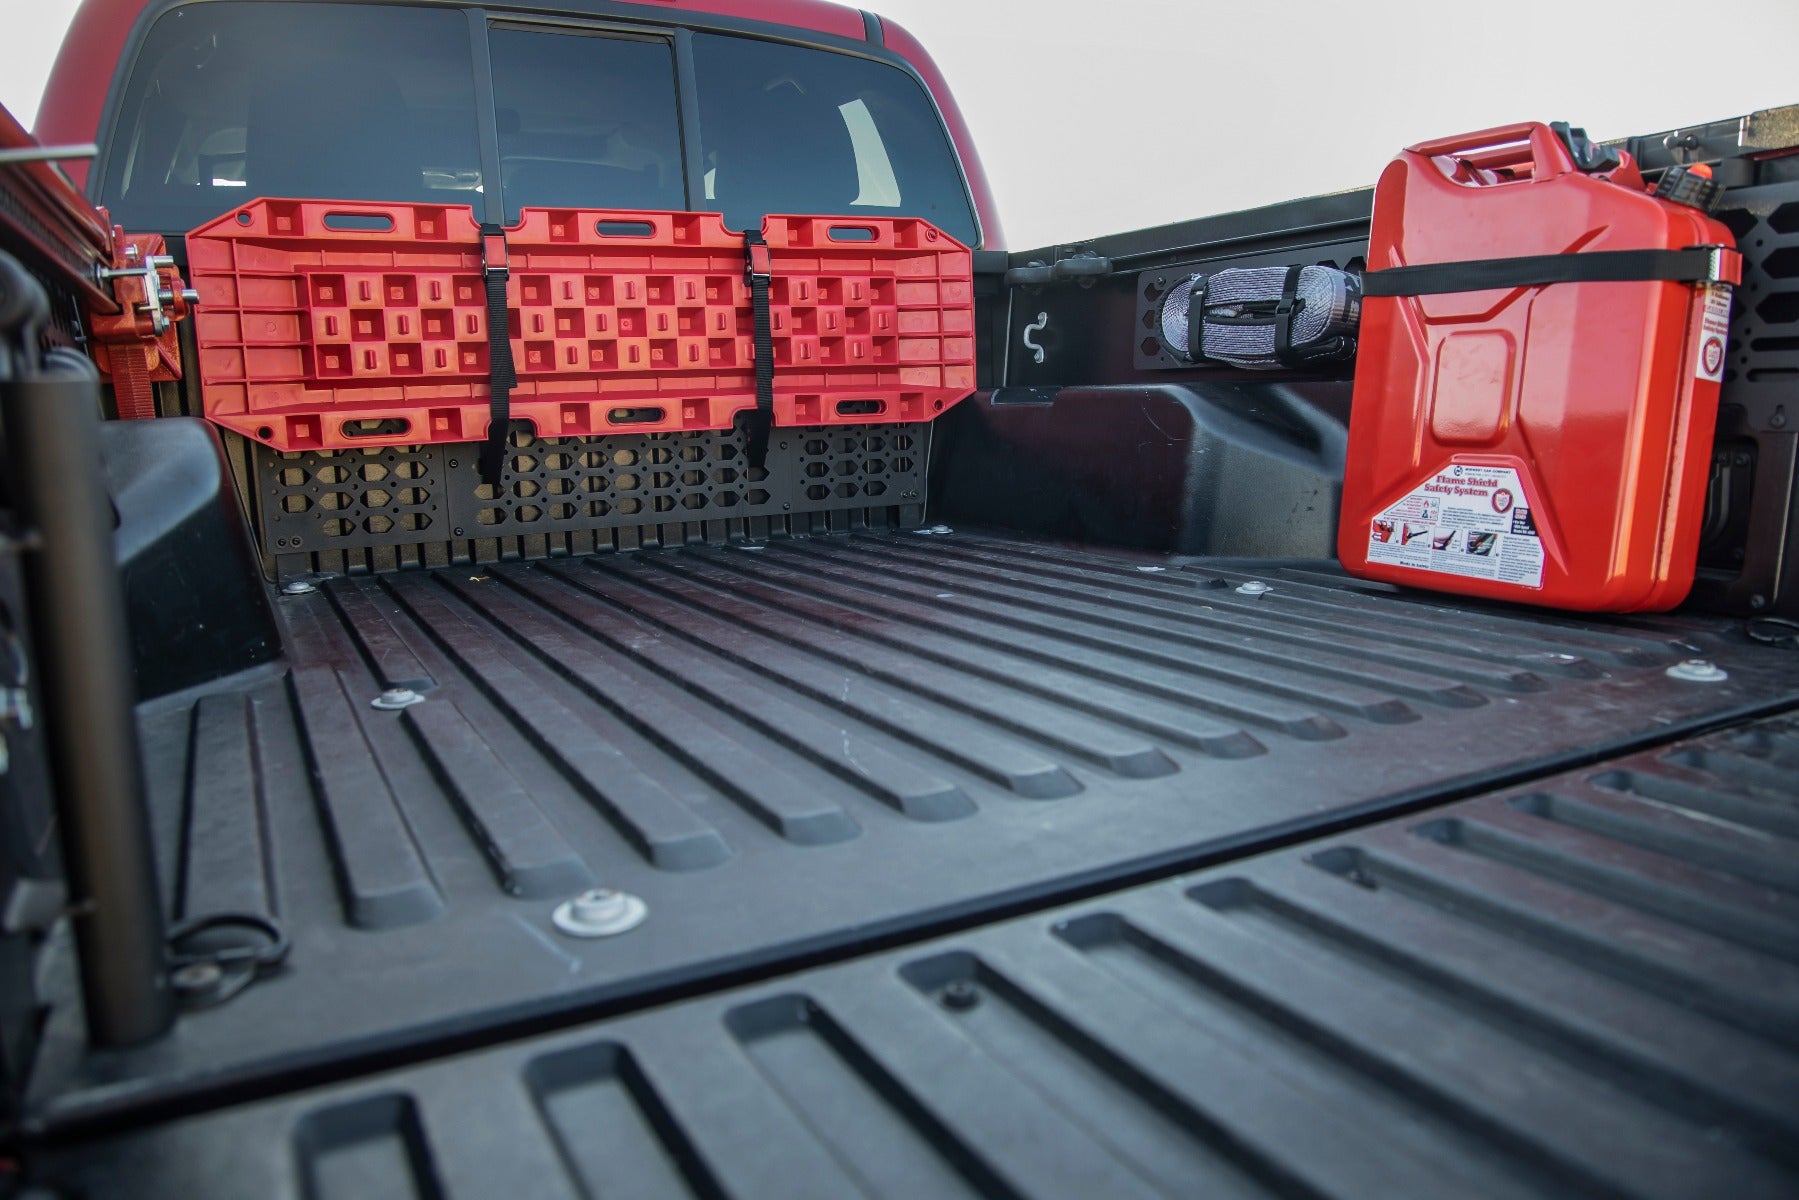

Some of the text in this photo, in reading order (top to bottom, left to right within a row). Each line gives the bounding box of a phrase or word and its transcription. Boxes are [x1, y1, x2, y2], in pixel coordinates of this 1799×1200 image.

[1436, 475, 1498, 488] Flame Shield
[1424, 483, 1488, 497] Safety System
